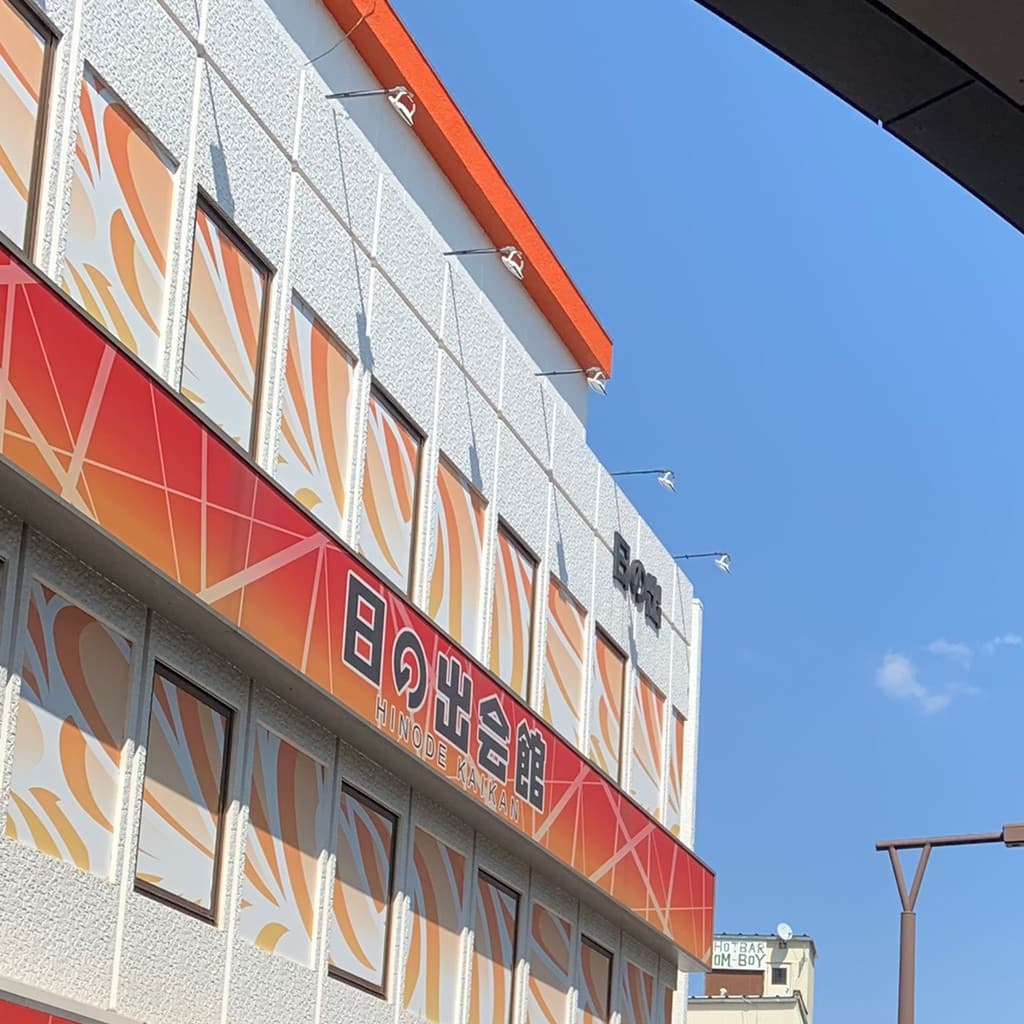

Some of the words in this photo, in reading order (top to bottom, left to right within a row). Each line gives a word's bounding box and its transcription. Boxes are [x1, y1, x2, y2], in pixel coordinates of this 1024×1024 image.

[343, 570, 546, 812] 日の出会館
[376, 697, 447, 769] HINODE
[457, 755, 519, 821] KAIKAN
